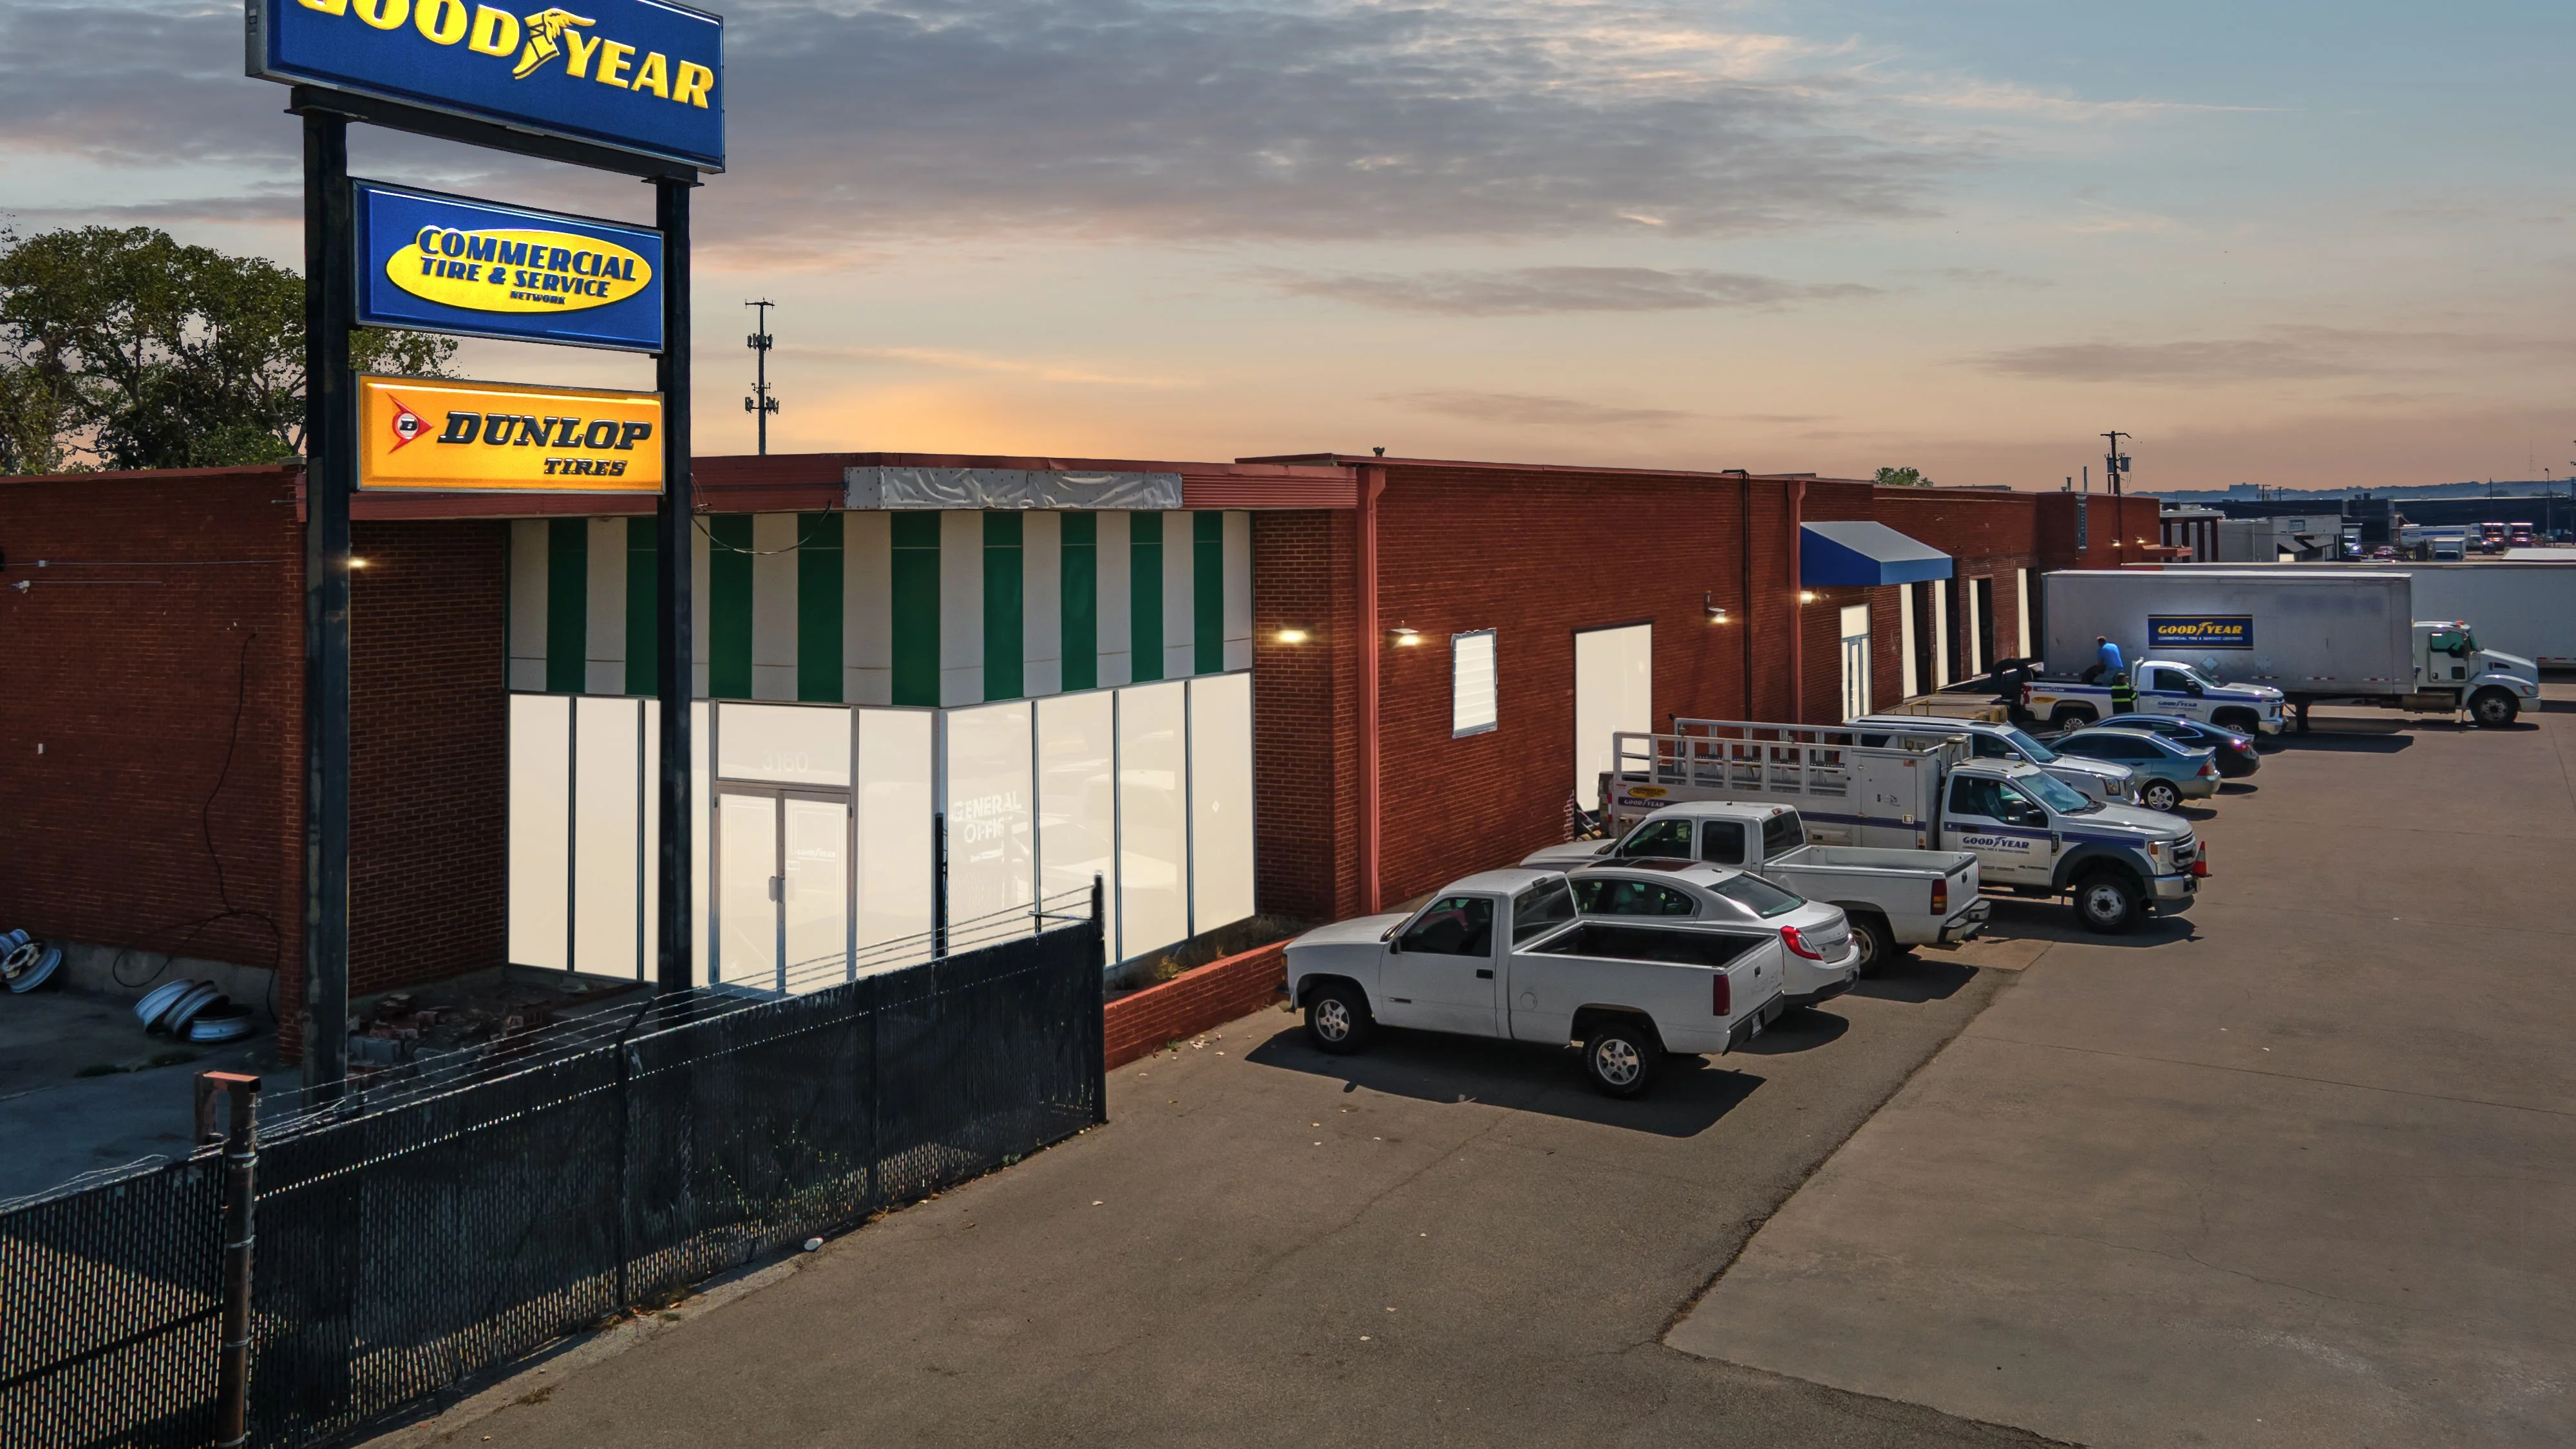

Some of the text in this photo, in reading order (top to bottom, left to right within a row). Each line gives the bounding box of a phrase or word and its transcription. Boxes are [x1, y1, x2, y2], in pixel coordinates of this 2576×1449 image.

[297, 0, 714, 109] OODYEAR
[419, 229, 636, 282] COMMERCIAL
[421, 255, 611, 298] TIRE & SERVICE
[510, 290, 566, 305] NETWORK
[437, 411, 652, 450] DUNLOP
[544, 457, 628, 477] TIRES
[951, 790, 1022, 822] GENERAL
